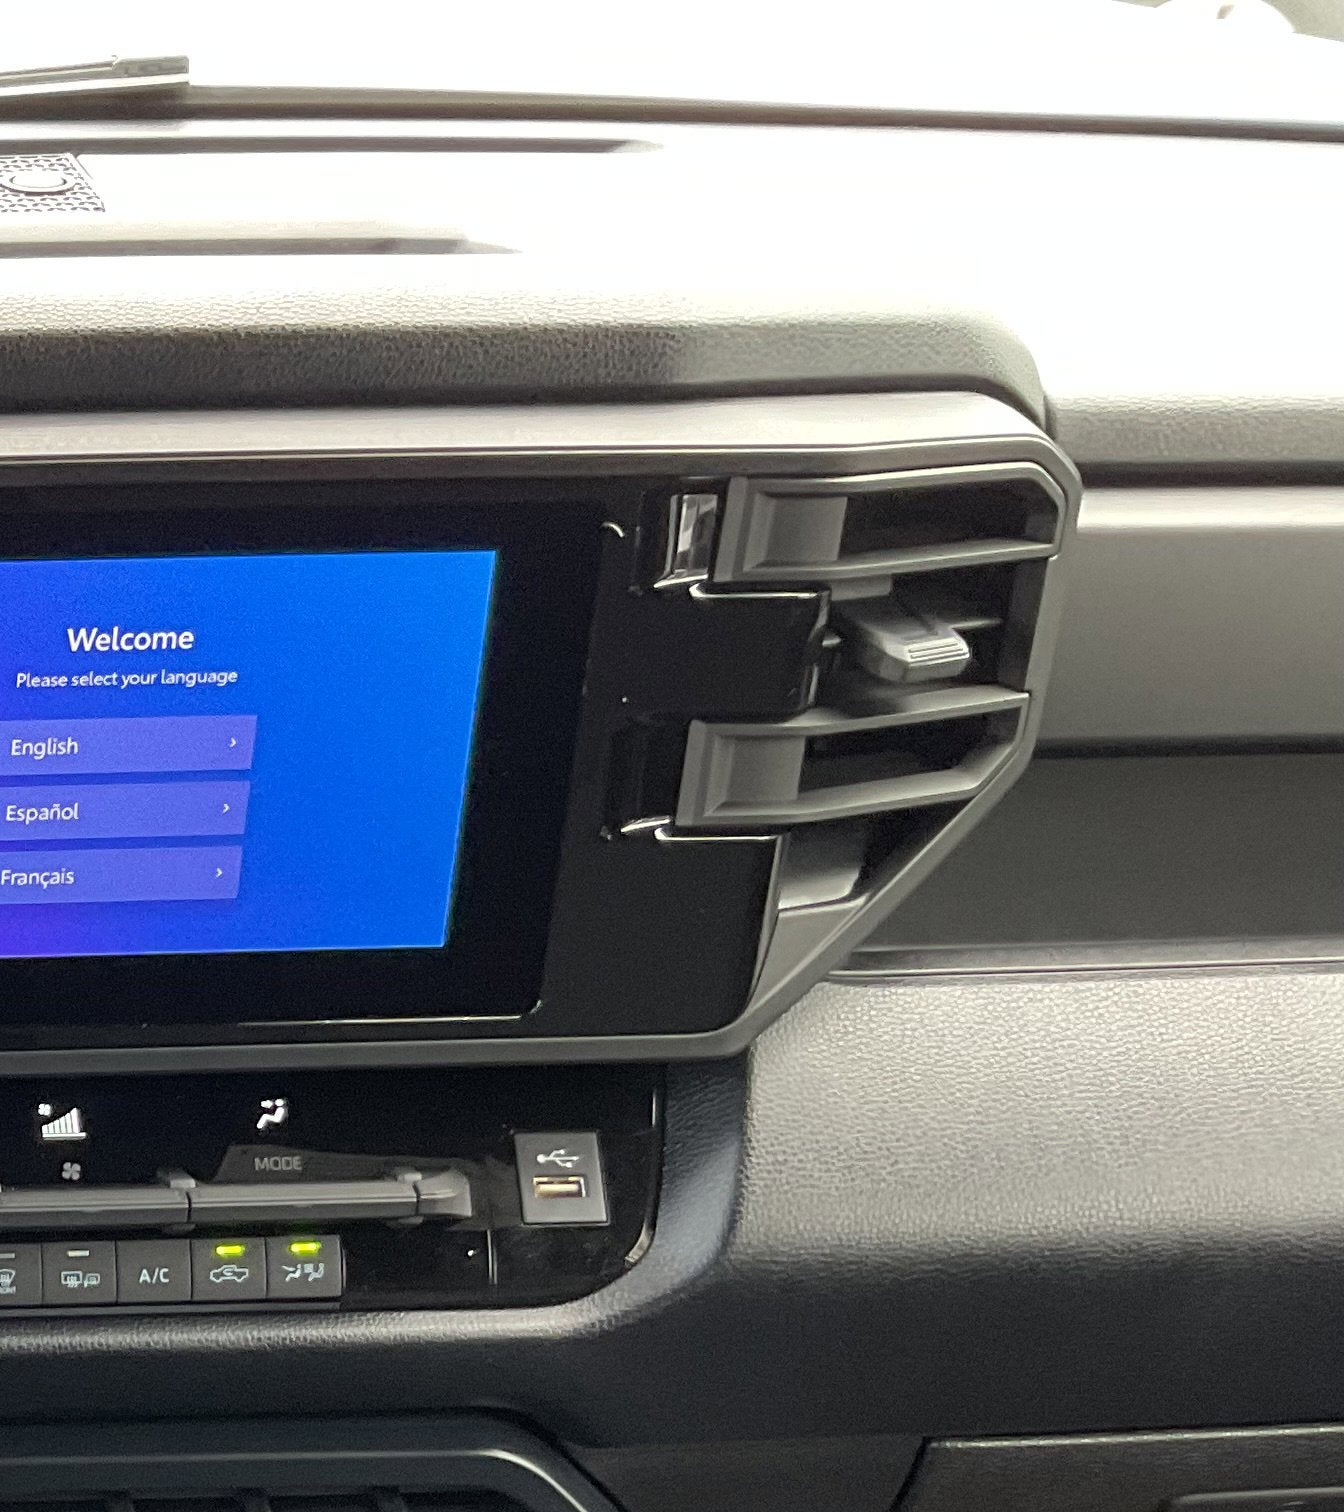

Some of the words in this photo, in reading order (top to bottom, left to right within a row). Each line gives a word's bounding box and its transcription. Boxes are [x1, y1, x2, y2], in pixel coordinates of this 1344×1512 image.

[66, 624, 195, 655] Welcome
[15, 670, 70, 691] Please
[71, 668, 118, 690] select
[120, 670, 158, 689] your
[159, 666, 239, 690] language
[9, 736, 80, 761] English
[4, 800, 80, 827] Español
[0, 865, 76, 891] Français
[253, 1154, 304, 1174] MODE
[138, 1266, 171, 1285] A/C
